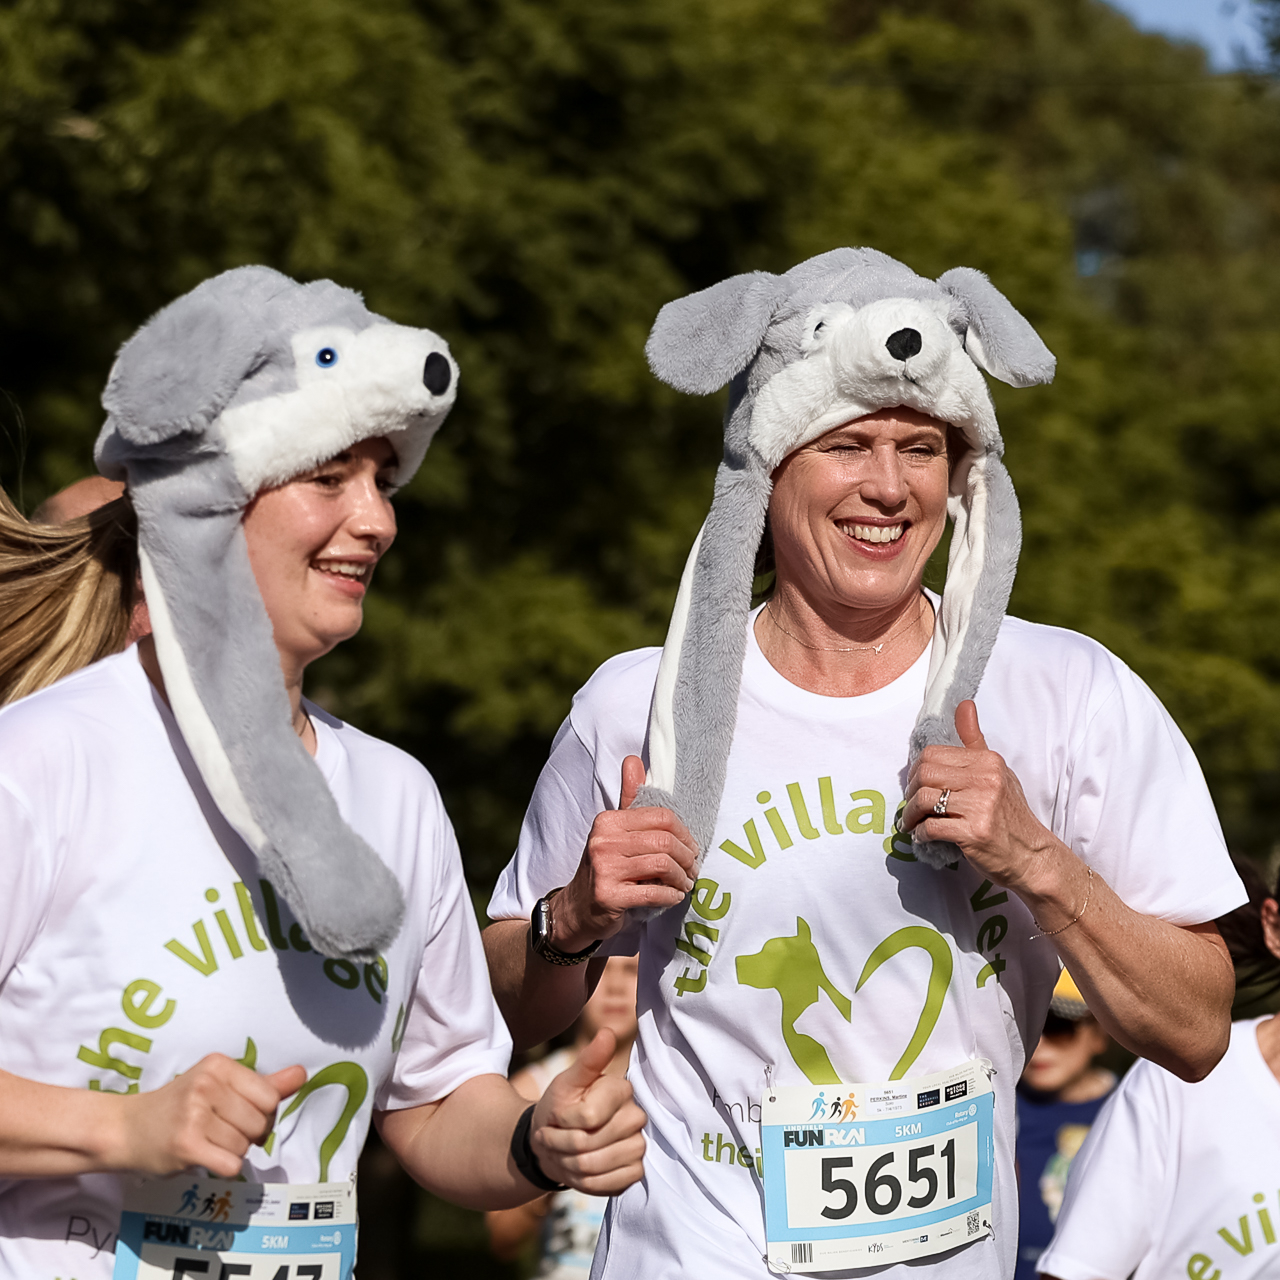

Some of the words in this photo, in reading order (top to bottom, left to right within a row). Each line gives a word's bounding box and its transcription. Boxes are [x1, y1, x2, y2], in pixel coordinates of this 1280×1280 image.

[673, 877, 731, 997] the
[784, 1130, 824, 1148] FUN
[895, 1122, 922, 1138] 5KM
[820, 1137, 956, 1220] 5651
[143, 1220, 190, 1244] FUN
[261, 1234, 289, 1249] 5KM
